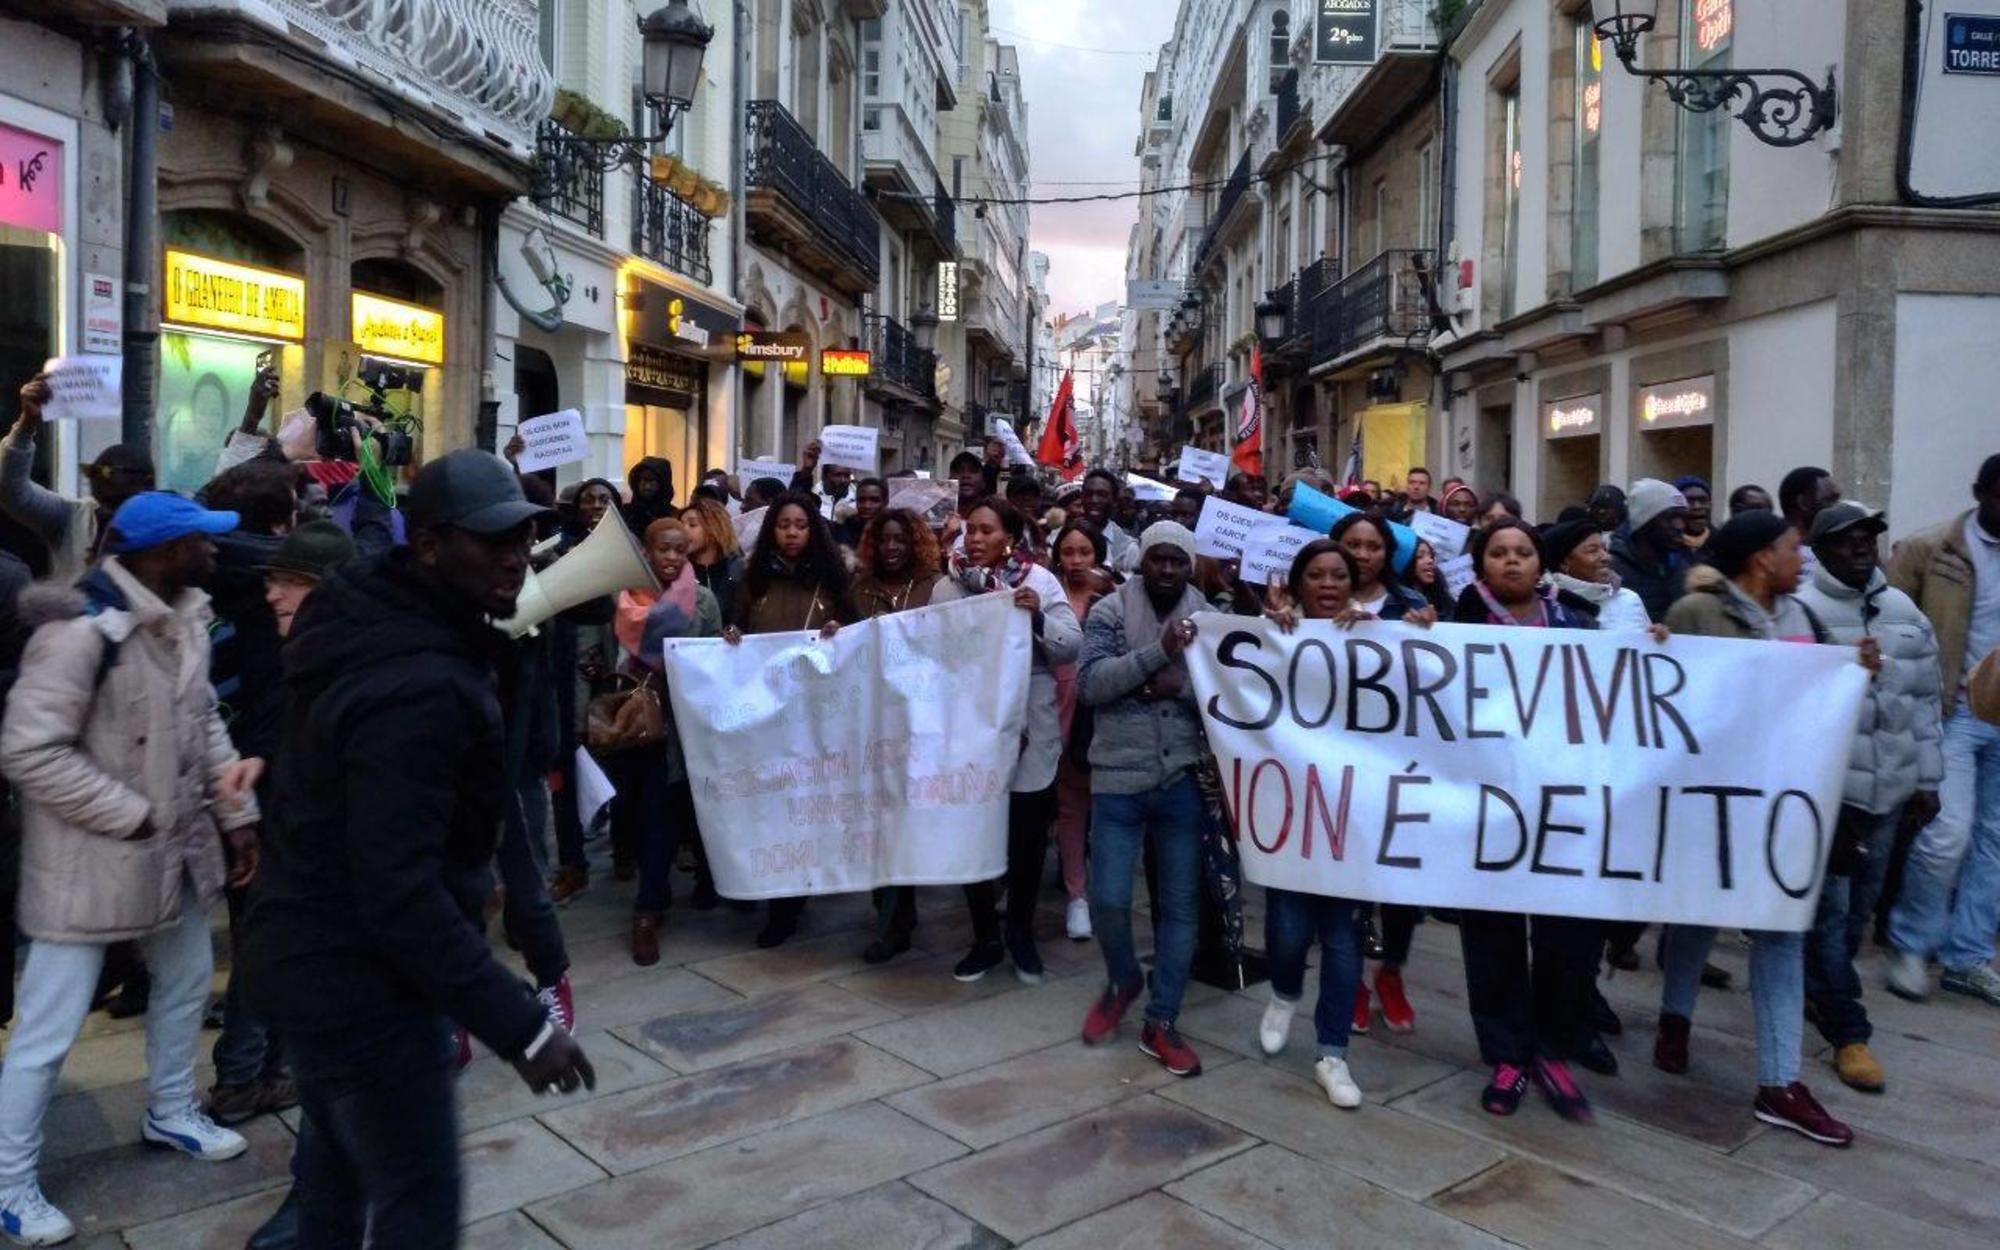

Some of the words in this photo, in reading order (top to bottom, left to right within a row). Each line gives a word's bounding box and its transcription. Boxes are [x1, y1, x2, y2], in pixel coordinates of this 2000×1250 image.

[174, 267, 181, 305] O
[246, 281, 260, 318] DE
[1207, 630, 1700, 754] SOBREVIVIR
[1376, 760, 1432, 869] É
[1473, 784, 1823, 899] DELITO
